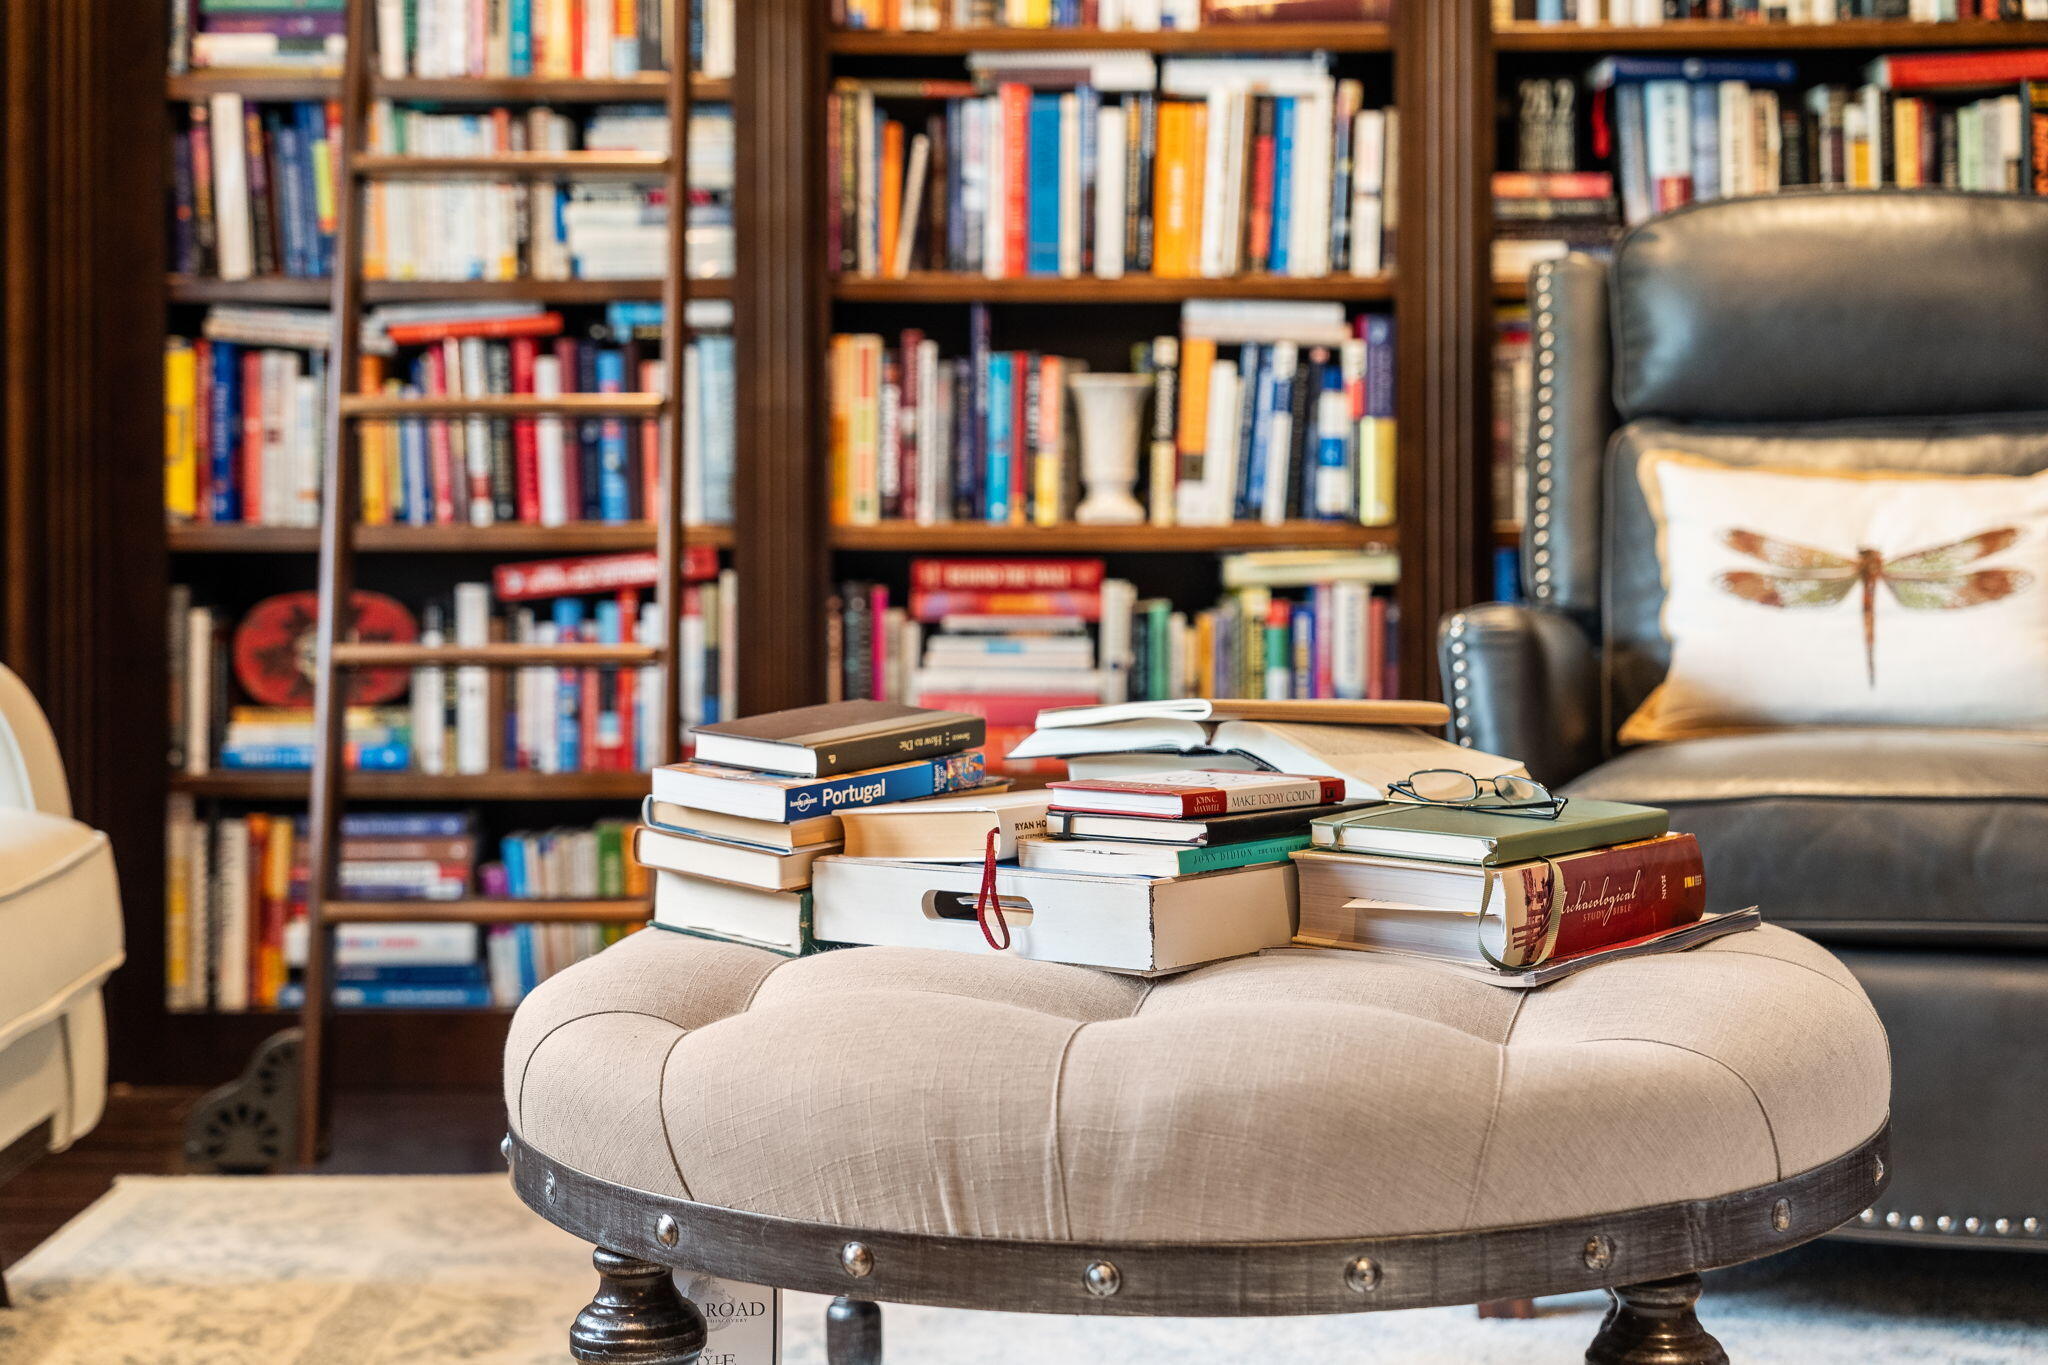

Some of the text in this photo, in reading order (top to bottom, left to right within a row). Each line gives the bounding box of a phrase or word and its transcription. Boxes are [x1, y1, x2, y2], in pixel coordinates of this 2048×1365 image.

[822, 778, 886, 807] Portugal
[1231, 789, 1317, 808] MAKE TODAY COUNT
[1014, 821, 1035, 831] RYAN
[1220, 848, 1252, 861] DIDION
[1583, 904, 1632, 922] STUDY BIBLE
[706, 1301, 765, 1317] ROAD
